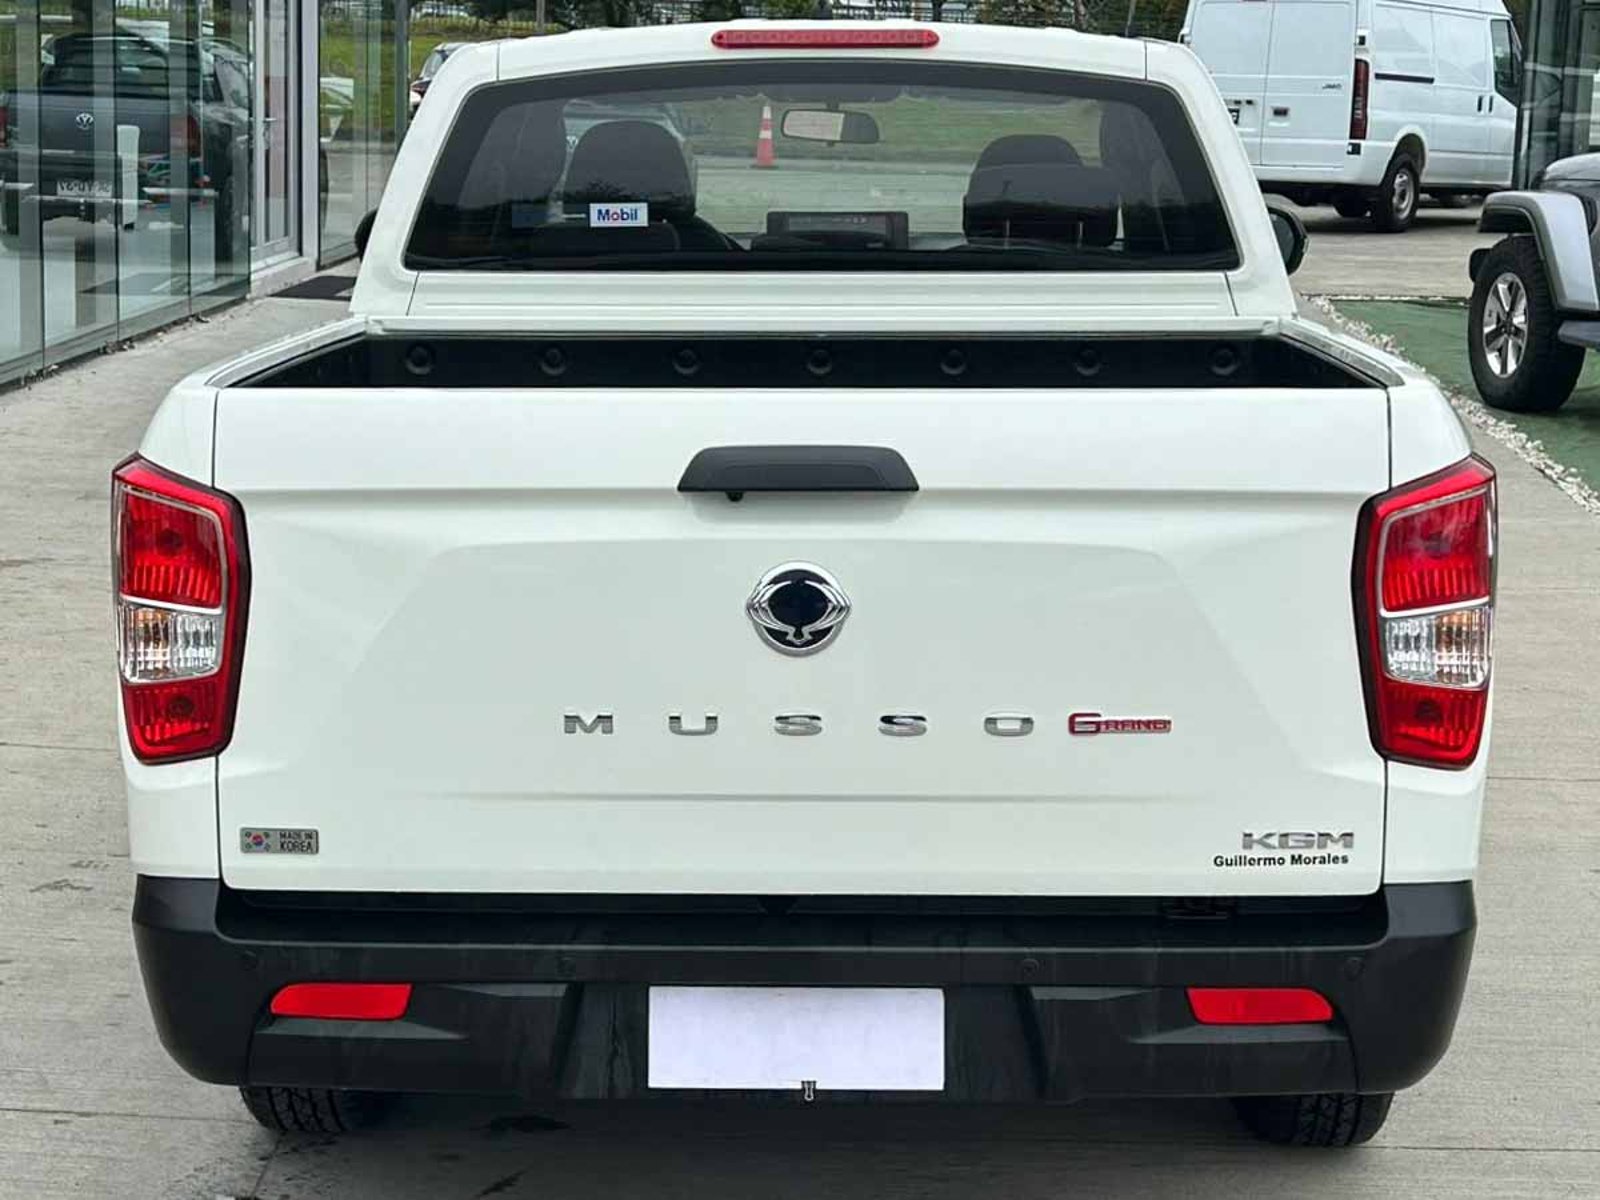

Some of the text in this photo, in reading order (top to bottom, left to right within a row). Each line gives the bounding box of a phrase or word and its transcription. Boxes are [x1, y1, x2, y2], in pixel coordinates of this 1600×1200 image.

[597, 208, 638, 221] Mobil
[564, 712, 1034, 736] MUSSO
[279, 832, 313, 840] MADE IN
[1242, 832, 1355, 850] KGM
[280, 840, 313, 852] KOREA
[1213, 853, 1349, 867] Guillermo Morales
